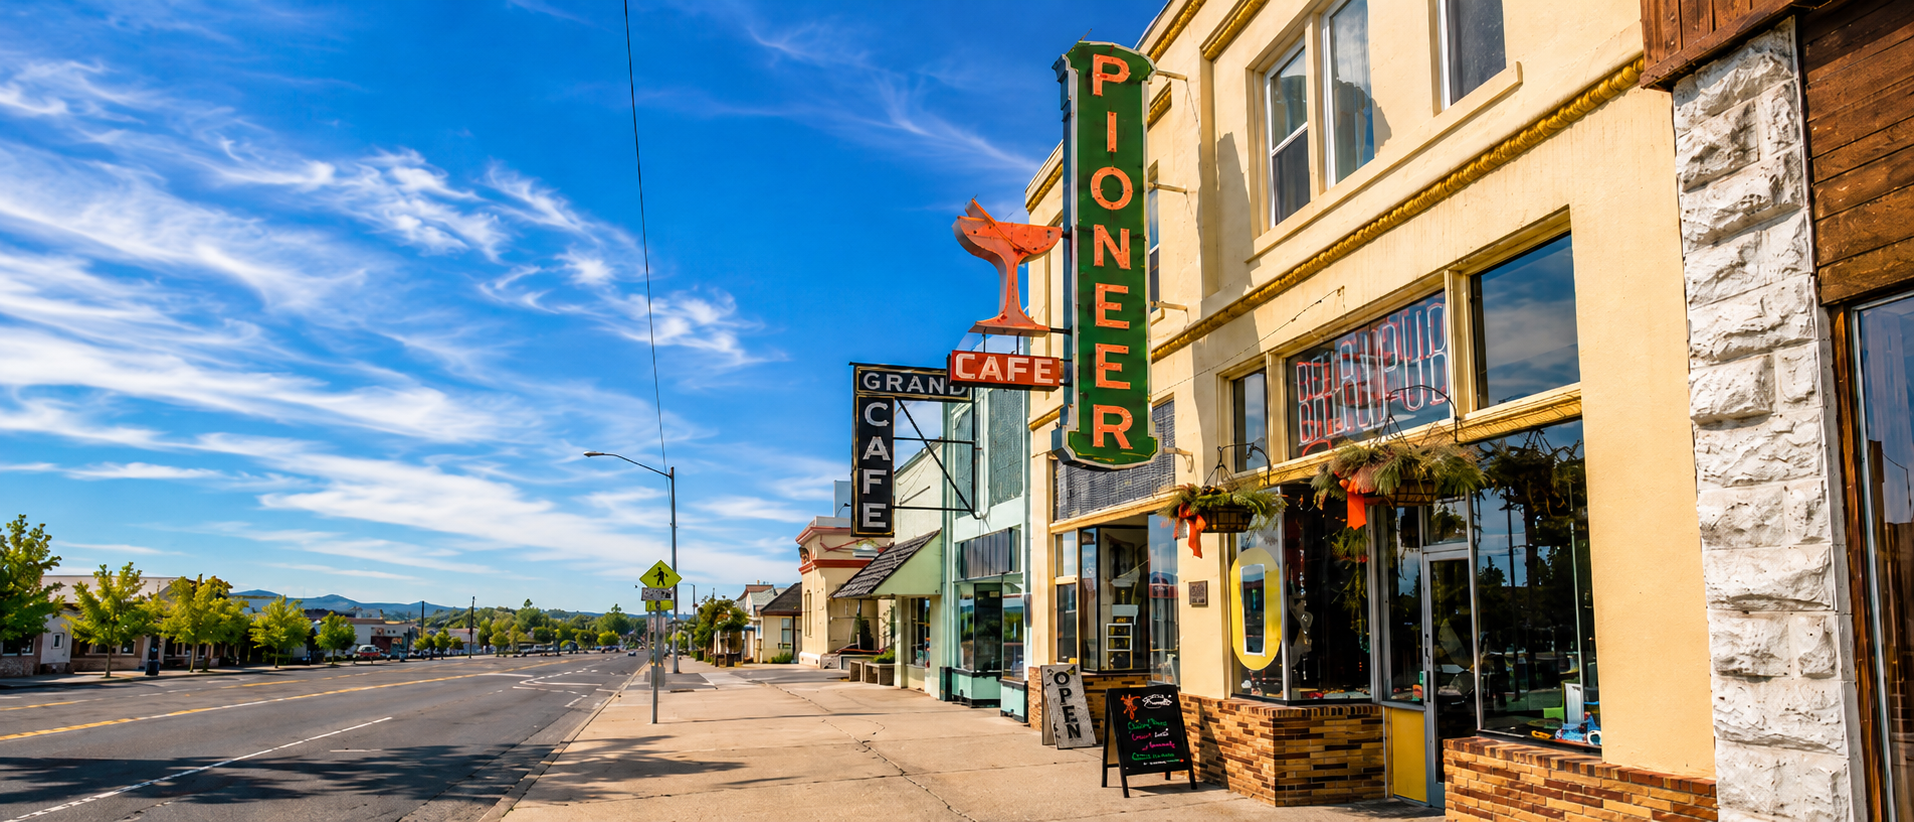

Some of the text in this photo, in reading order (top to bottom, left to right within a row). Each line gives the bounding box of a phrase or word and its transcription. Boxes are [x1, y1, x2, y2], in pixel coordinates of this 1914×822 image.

[1090, 53, 1134, 450] PIONEER
[955, 353, 1054, 385] CAFE
[862, 402, 891, 528] CAFE
[1053, 671, 1081, 739] OPEN
